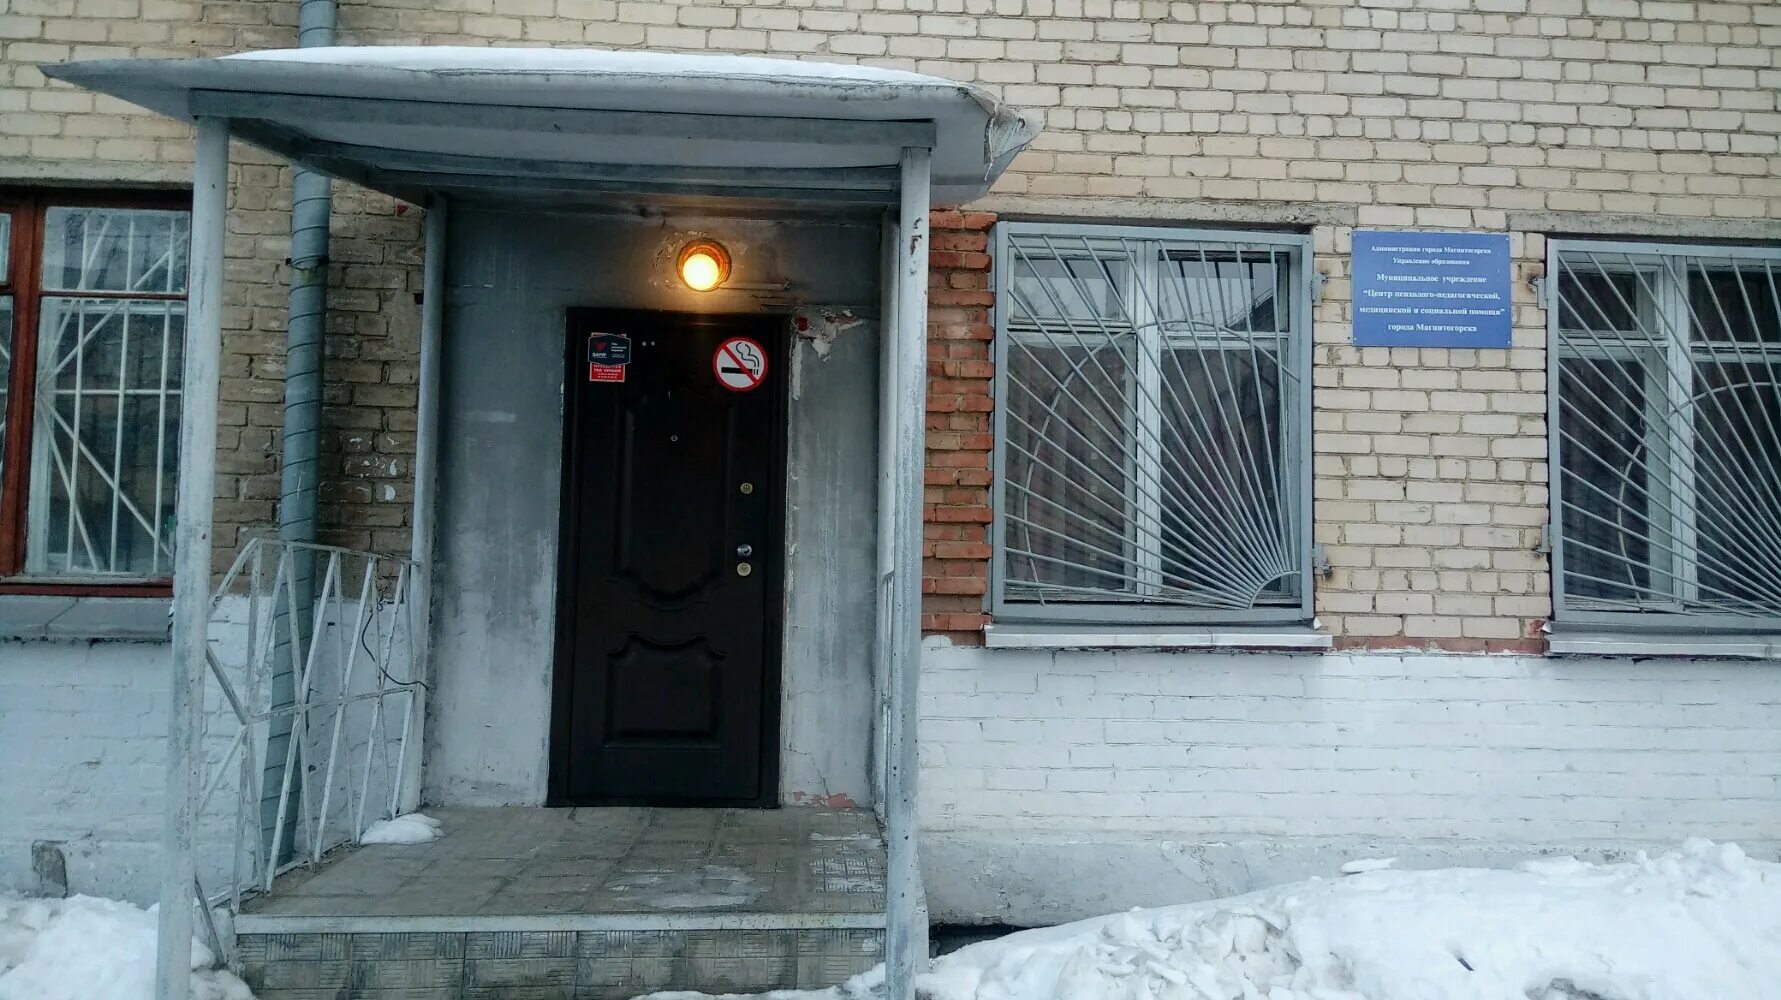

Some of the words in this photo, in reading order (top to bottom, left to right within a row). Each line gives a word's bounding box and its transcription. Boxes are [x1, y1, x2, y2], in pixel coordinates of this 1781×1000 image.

[1376, 274, 1439, 282] Муниципальное
[1359, 306, 1411, 314] медицинской
[1420, 307, 1467, 315] социальной
[1416, 324, 1477, 332] Магнитогорска
